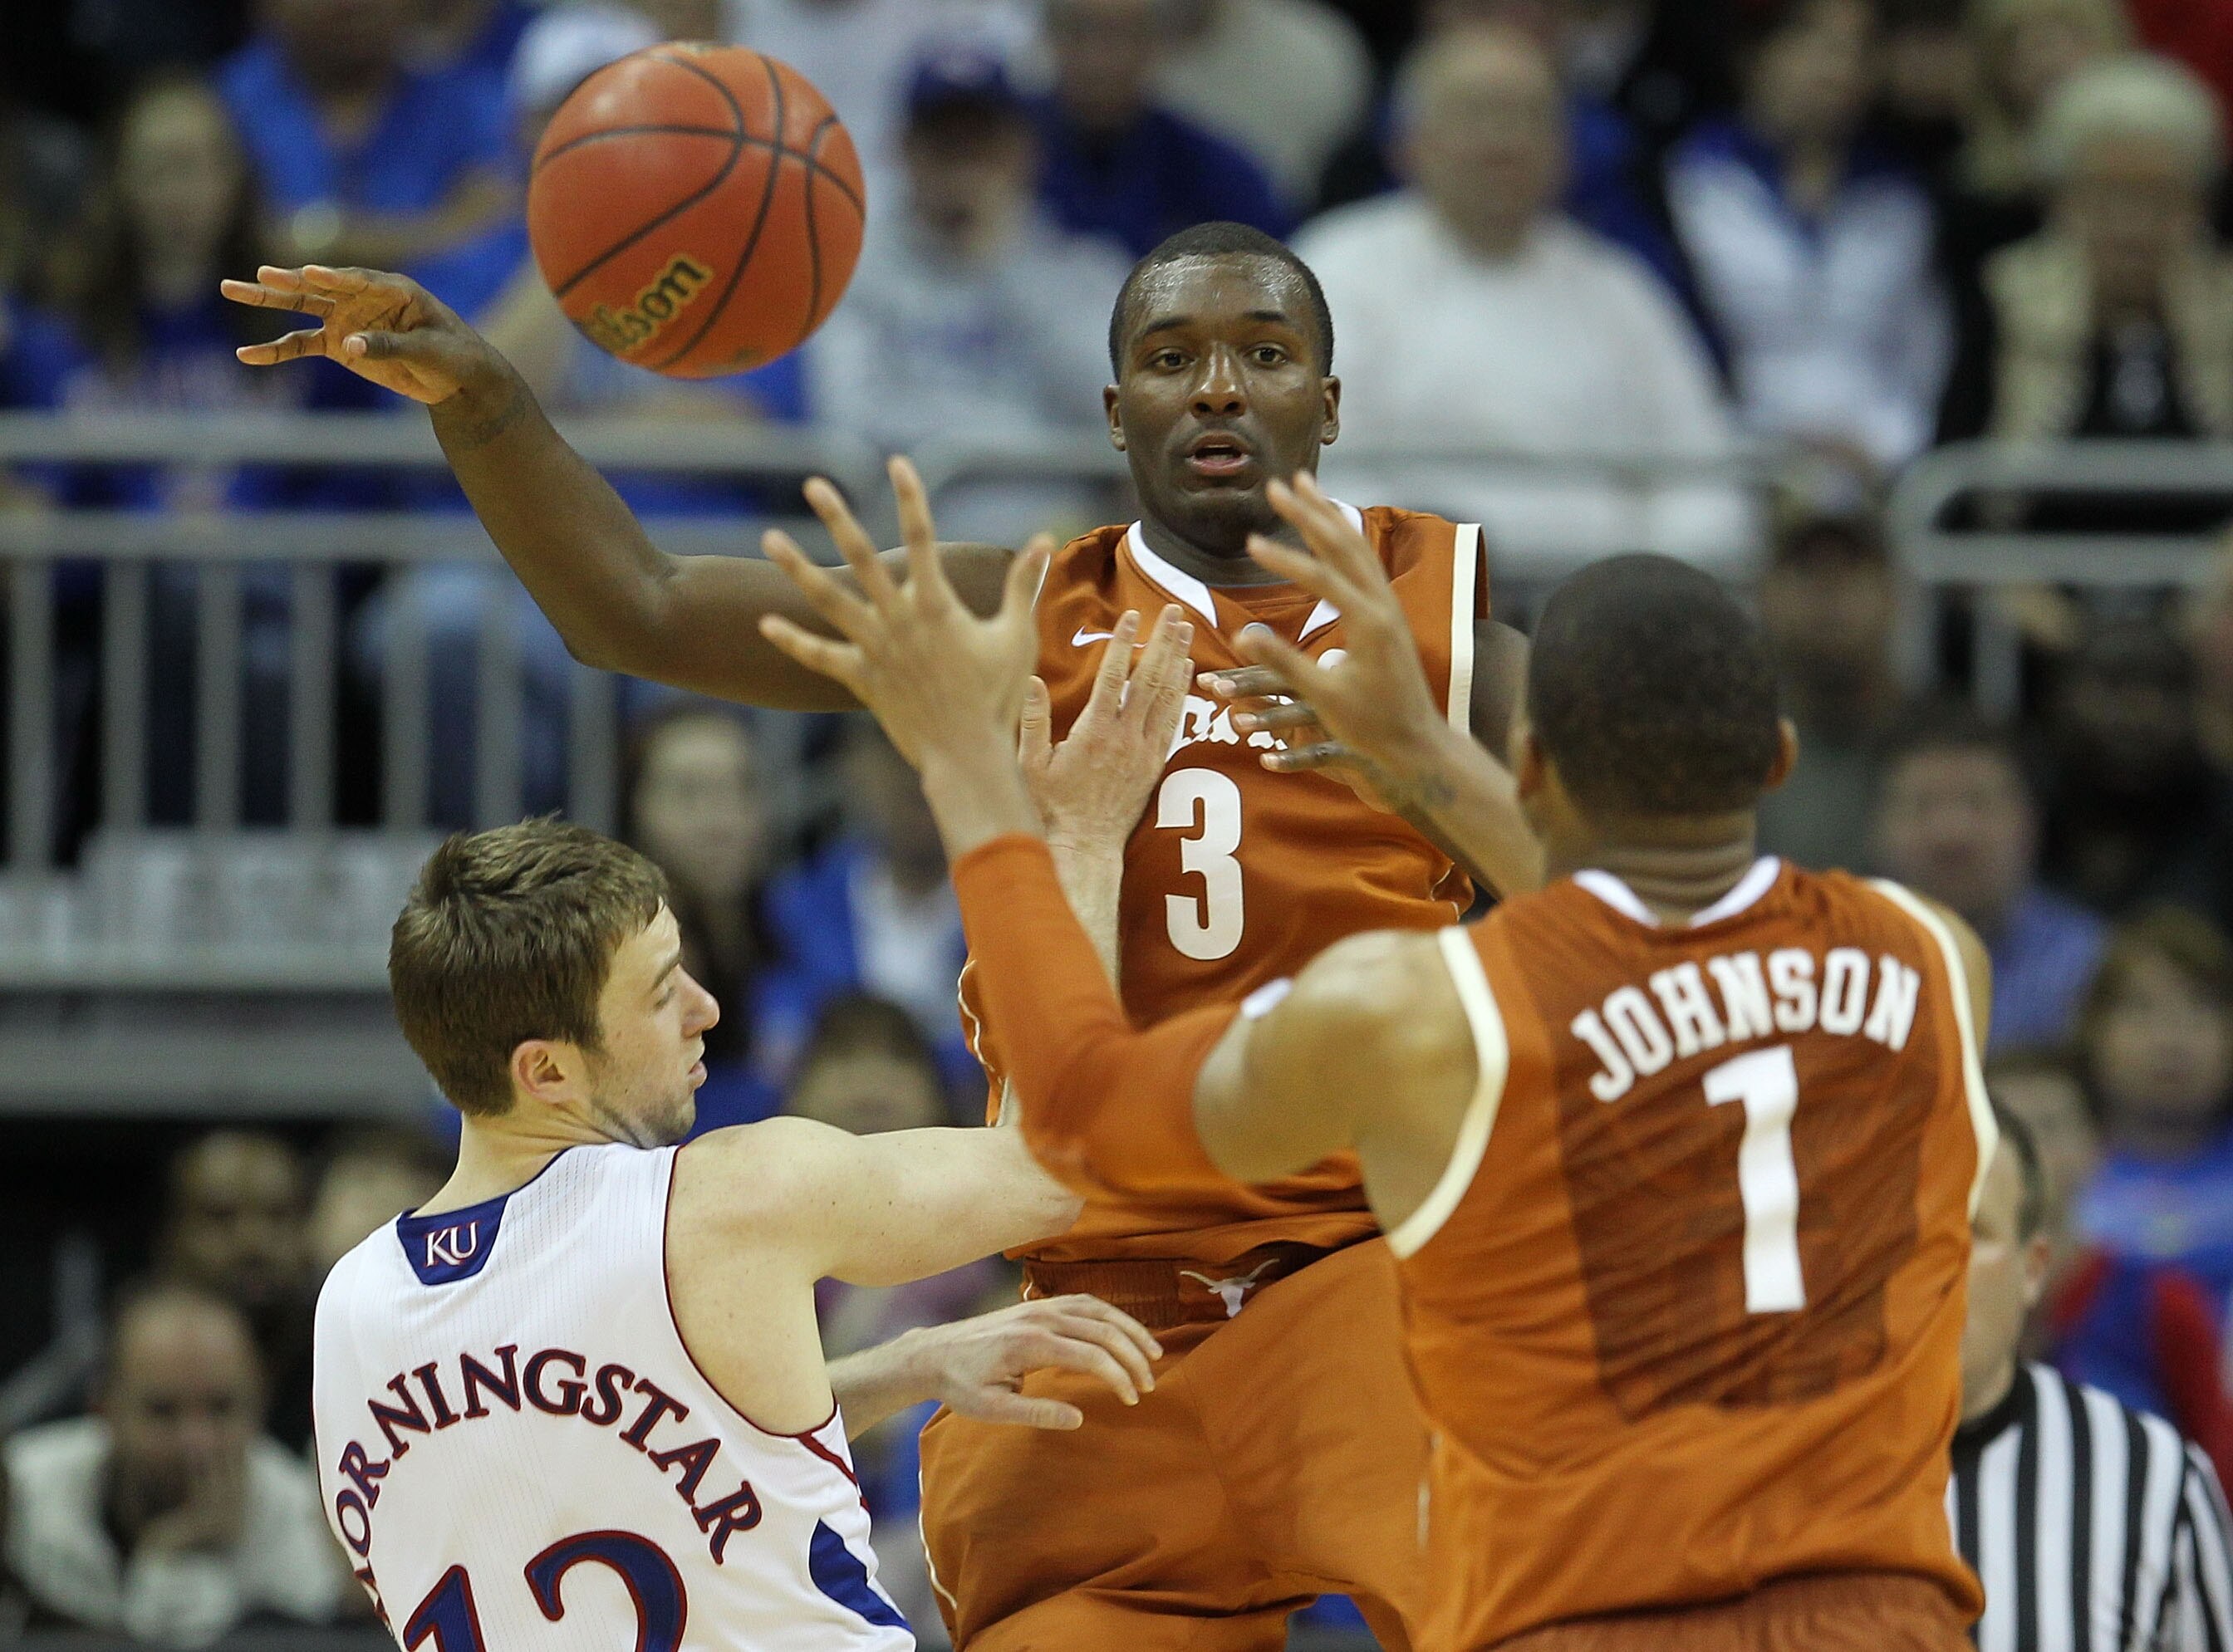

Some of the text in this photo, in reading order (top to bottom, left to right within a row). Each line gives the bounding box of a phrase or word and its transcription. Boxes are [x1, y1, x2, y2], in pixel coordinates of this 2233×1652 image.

[575, 252, 713, 352] lson
[1155, 767, 1244, 961] 3
[1571, 947, 1921, 1103] JOHNSON
[425, 1220, 478, 1267] KU
[1703, 1045, 1806, 1314] 1
